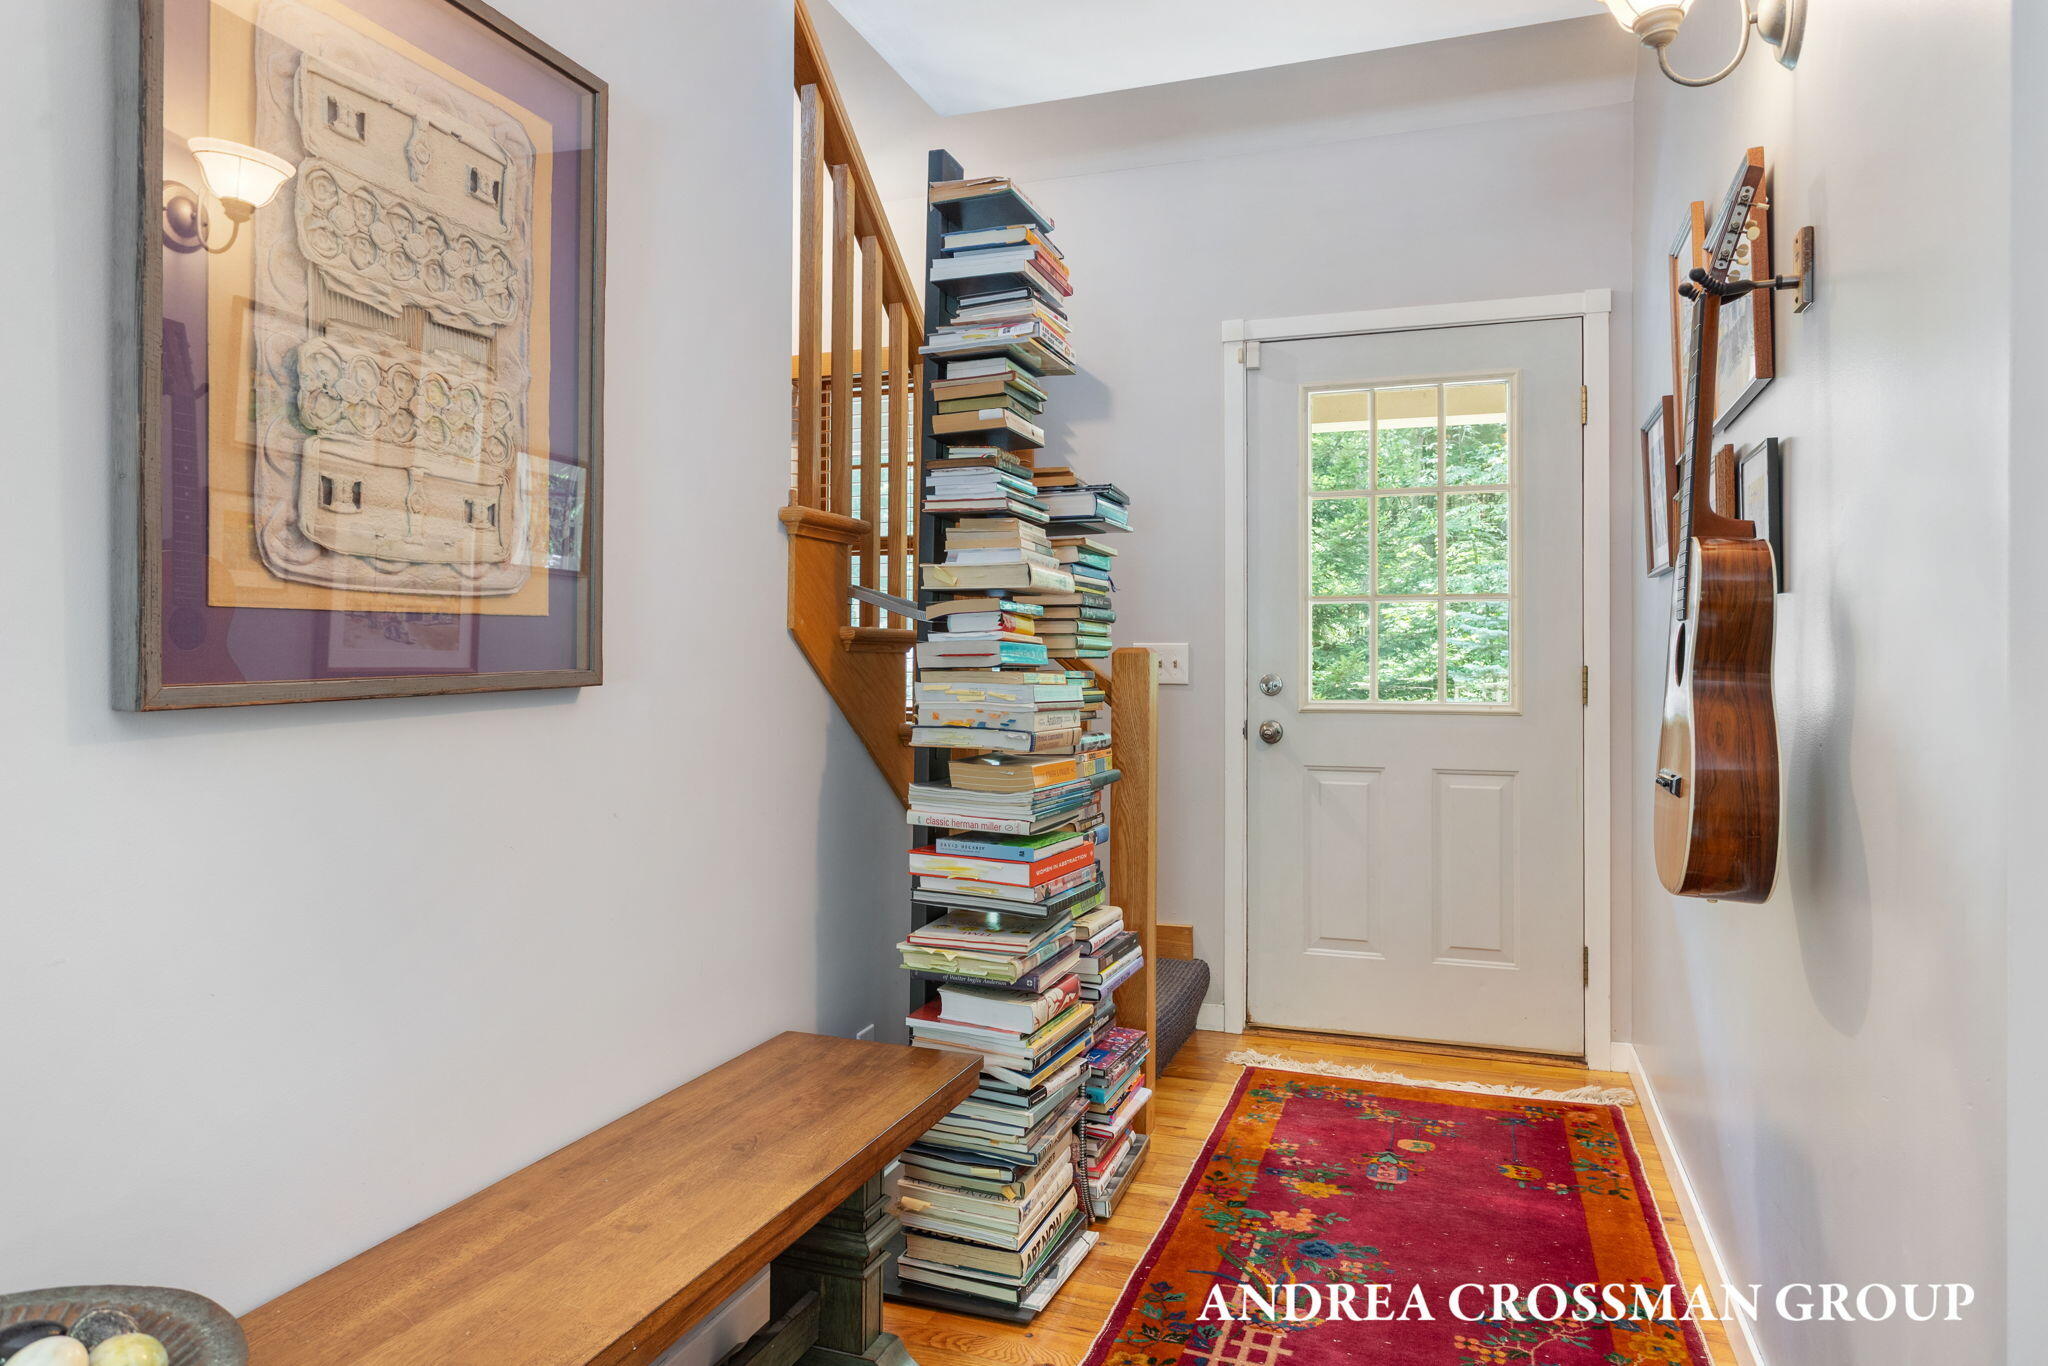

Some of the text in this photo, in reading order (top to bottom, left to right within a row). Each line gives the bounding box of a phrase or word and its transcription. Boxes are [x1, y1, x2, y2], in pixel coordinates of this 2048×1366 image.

[925, 816, 950, 827] classic
[951, 818, 979, 830] herman
[980, 821, 1001, 832] miller
[1035, 866, 1053, 876] WOMEN
[1058, 854, 1088, 867] ABSTRACTION
[942, 974, 948, 982] of
[949, 974, 966, 982] Walter
[983, 978, 1007, 986] Anderson
[1026, 1212, 1062, 1271] ART NOW
